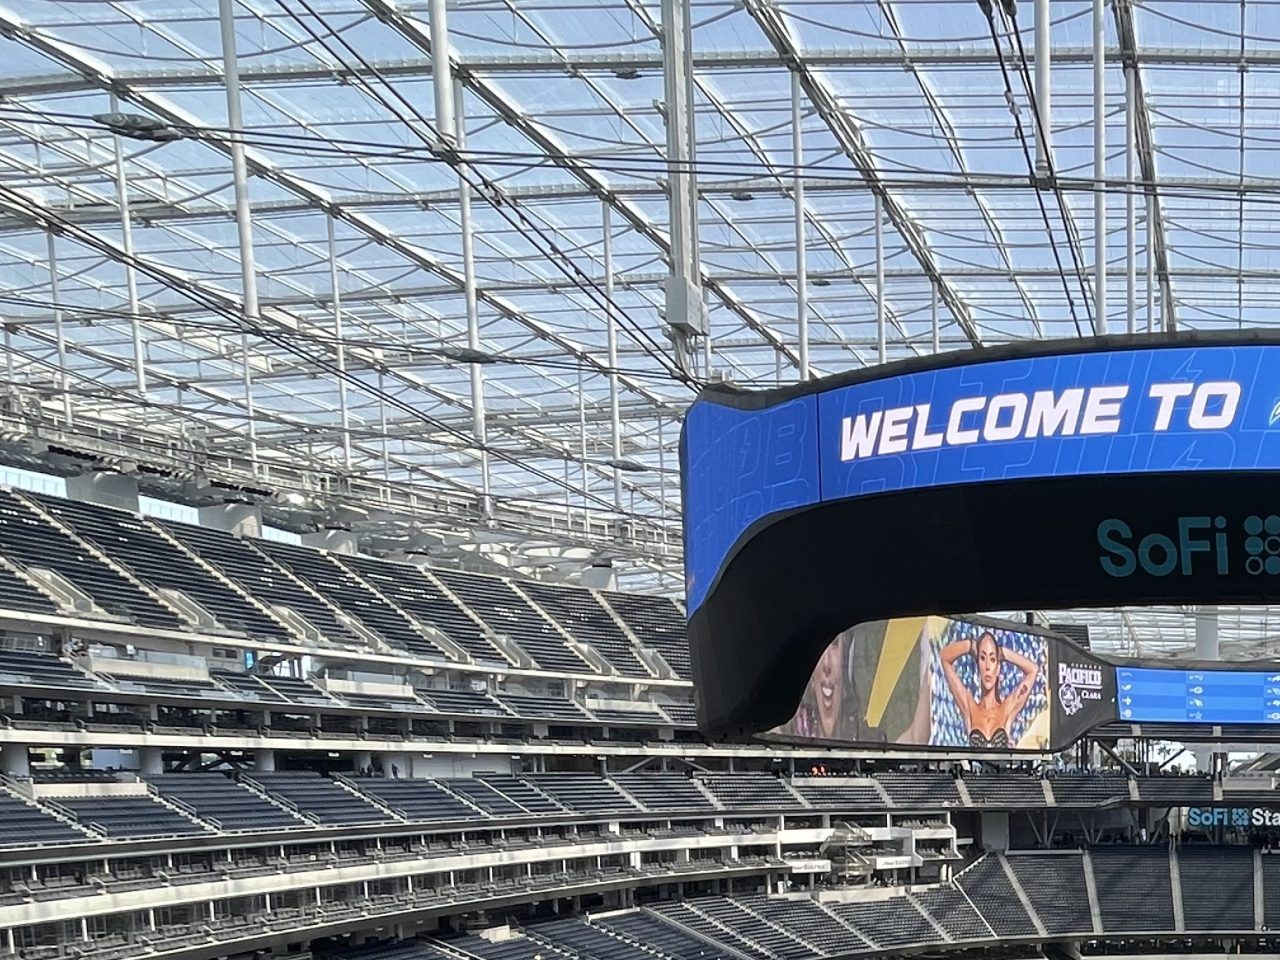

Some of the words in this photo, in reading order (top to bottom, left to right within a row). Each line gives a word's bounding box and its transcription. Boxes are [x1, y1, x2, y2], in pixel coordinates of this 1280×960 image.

[840, 384, 1129, 463] WELCOME
[1148, 380, 1242, 432] TO
[1097, 516, 1229, 577] SoFi
[1188, 807, 1228, 826] SoFi
